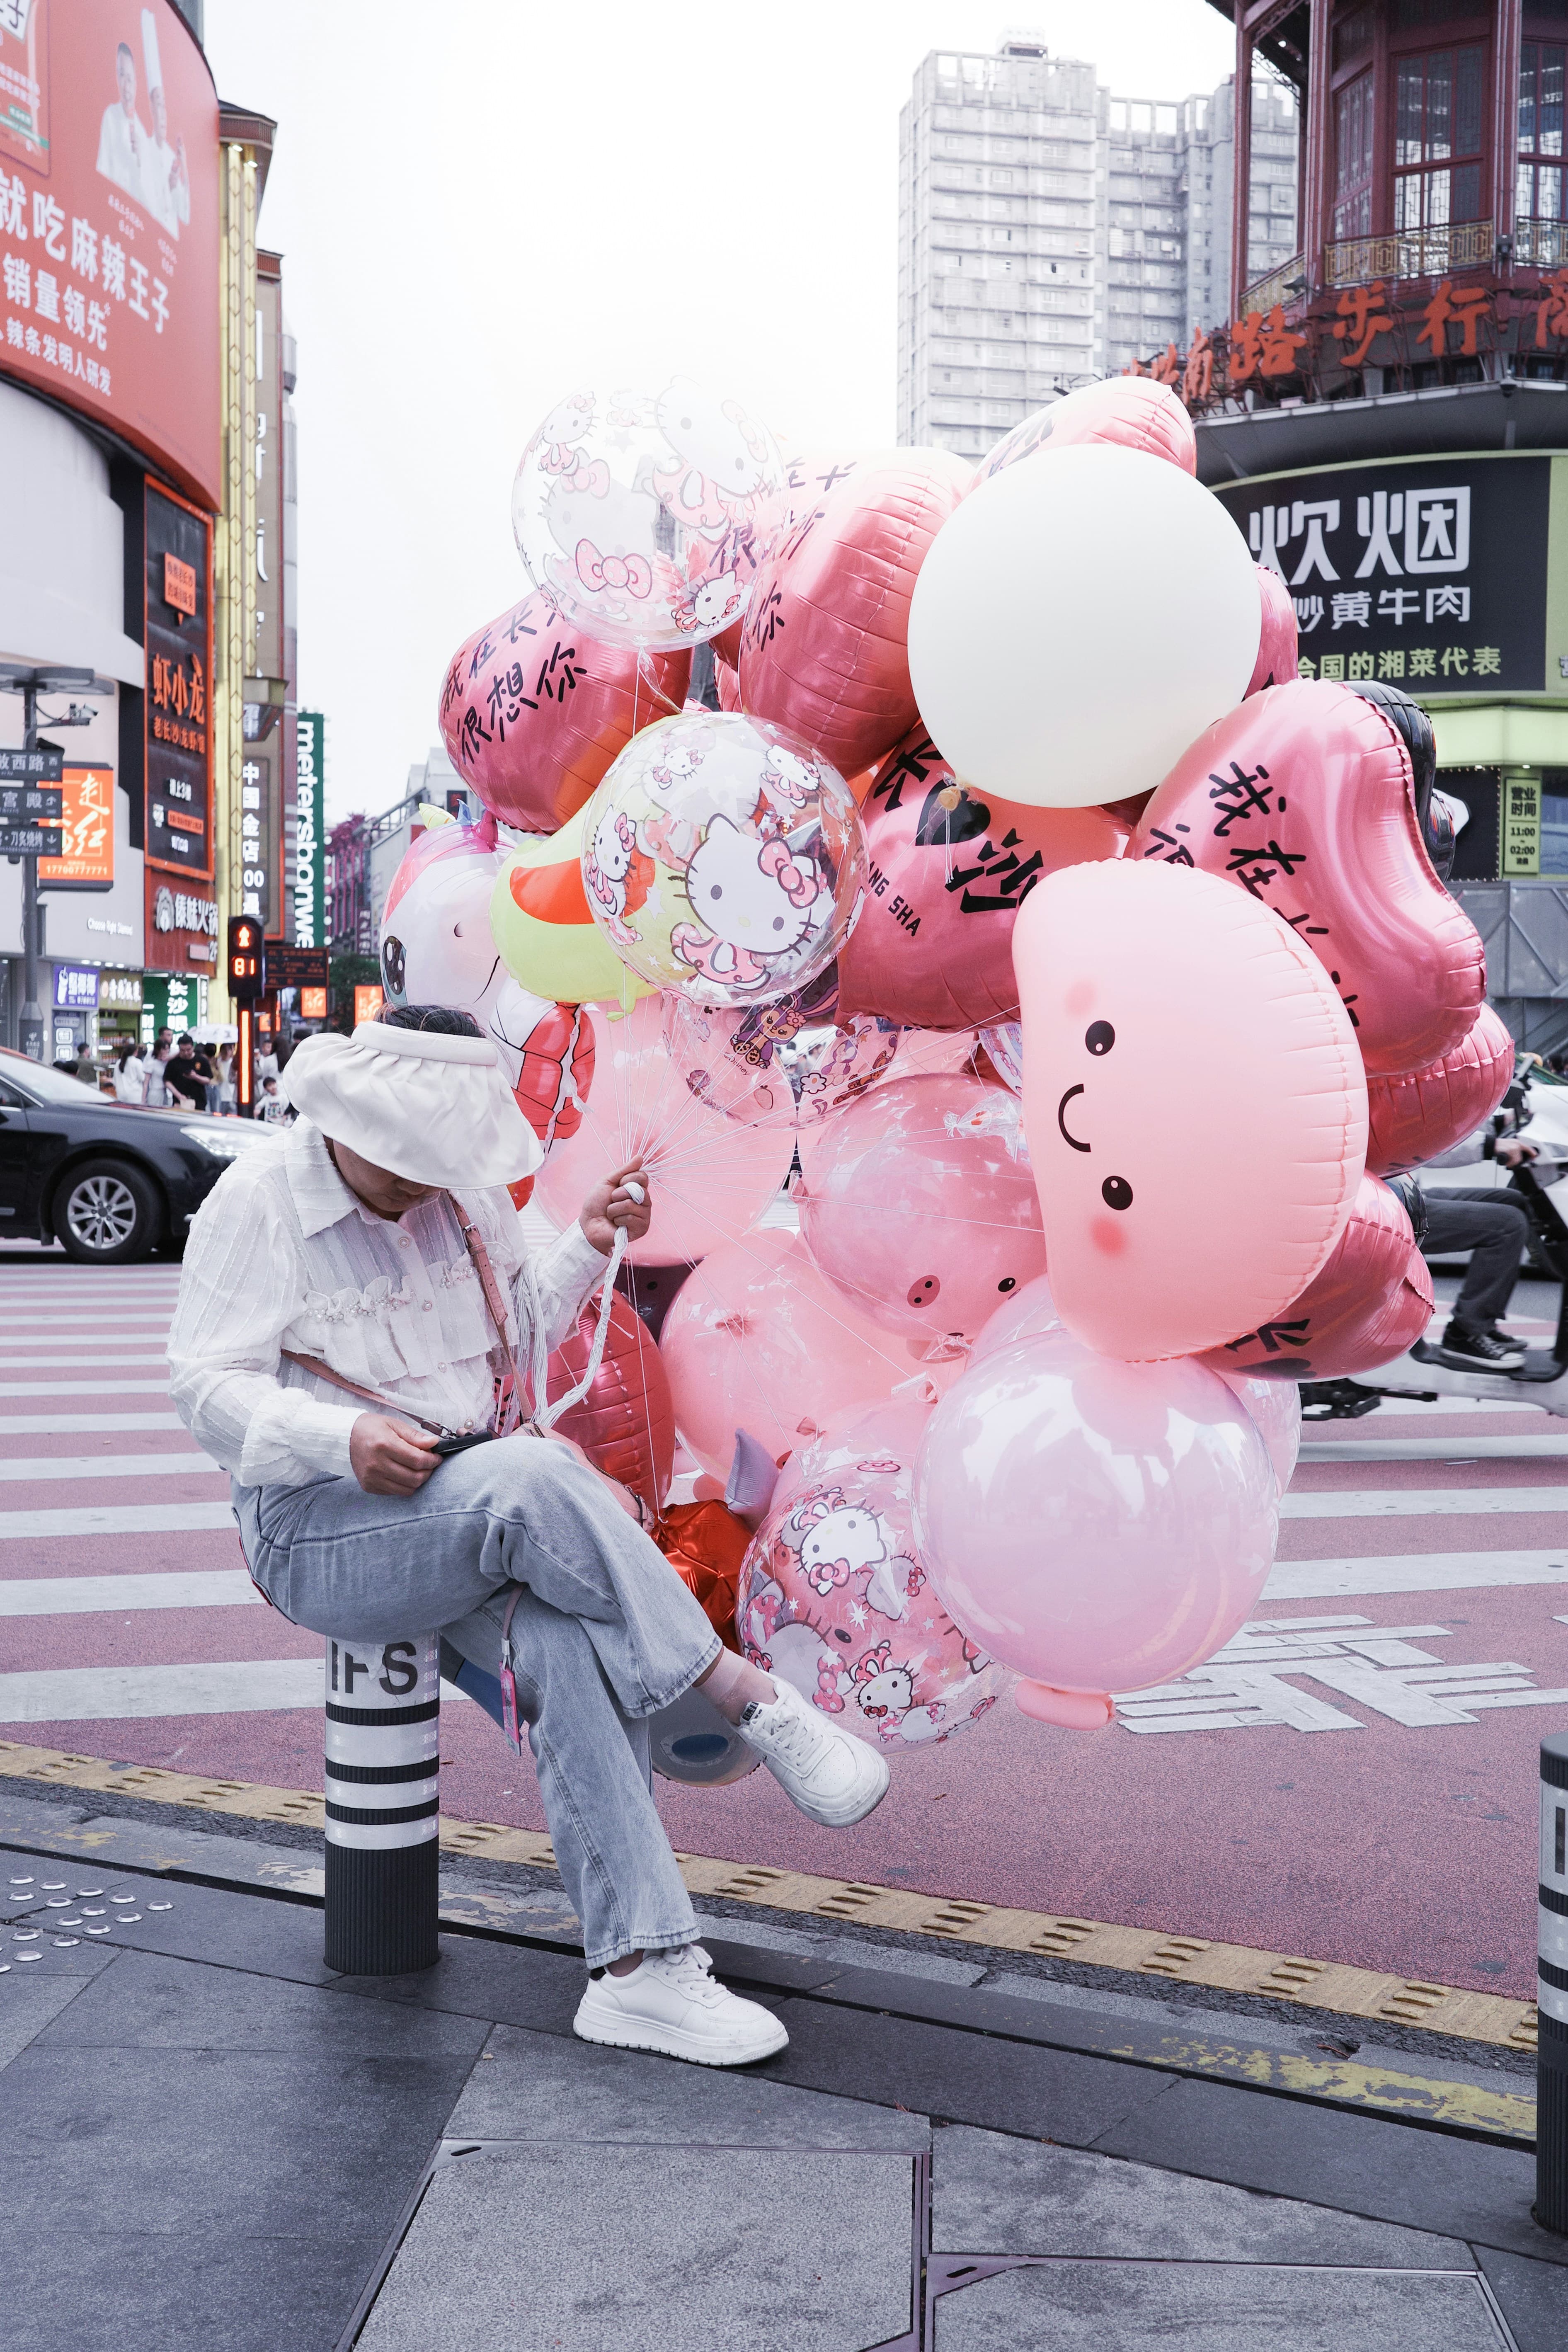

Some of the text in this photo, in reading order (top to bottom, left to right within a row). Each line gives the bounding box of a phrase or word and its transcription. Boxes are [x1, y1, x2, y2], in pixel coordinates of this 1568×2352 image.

[0, 170, 170, 333] 就吃麻辣王子
[2, 252, 107, 351] 销量领先
[0, 317, 111, 396] 辣条发明人研发
[1249, 486, 1471, 586] 炊烟
[1292, 585, 1471, 633] 炒黄牛肉
[458, 642, 587, 765] 很想你
[1511, 787, 1536, 800] 营业
[1511, 802, 1536, 816] 时间
[1510, 827, 1536, 836] 11:00
[1510, 846, 1536, 855] 02:00
[945, 828, 1044, 914] 沙
[888, 895, 921, 937] SHA
[234, 957, 254, 976] 81
[331, 1639, 418, 1695] IFS
